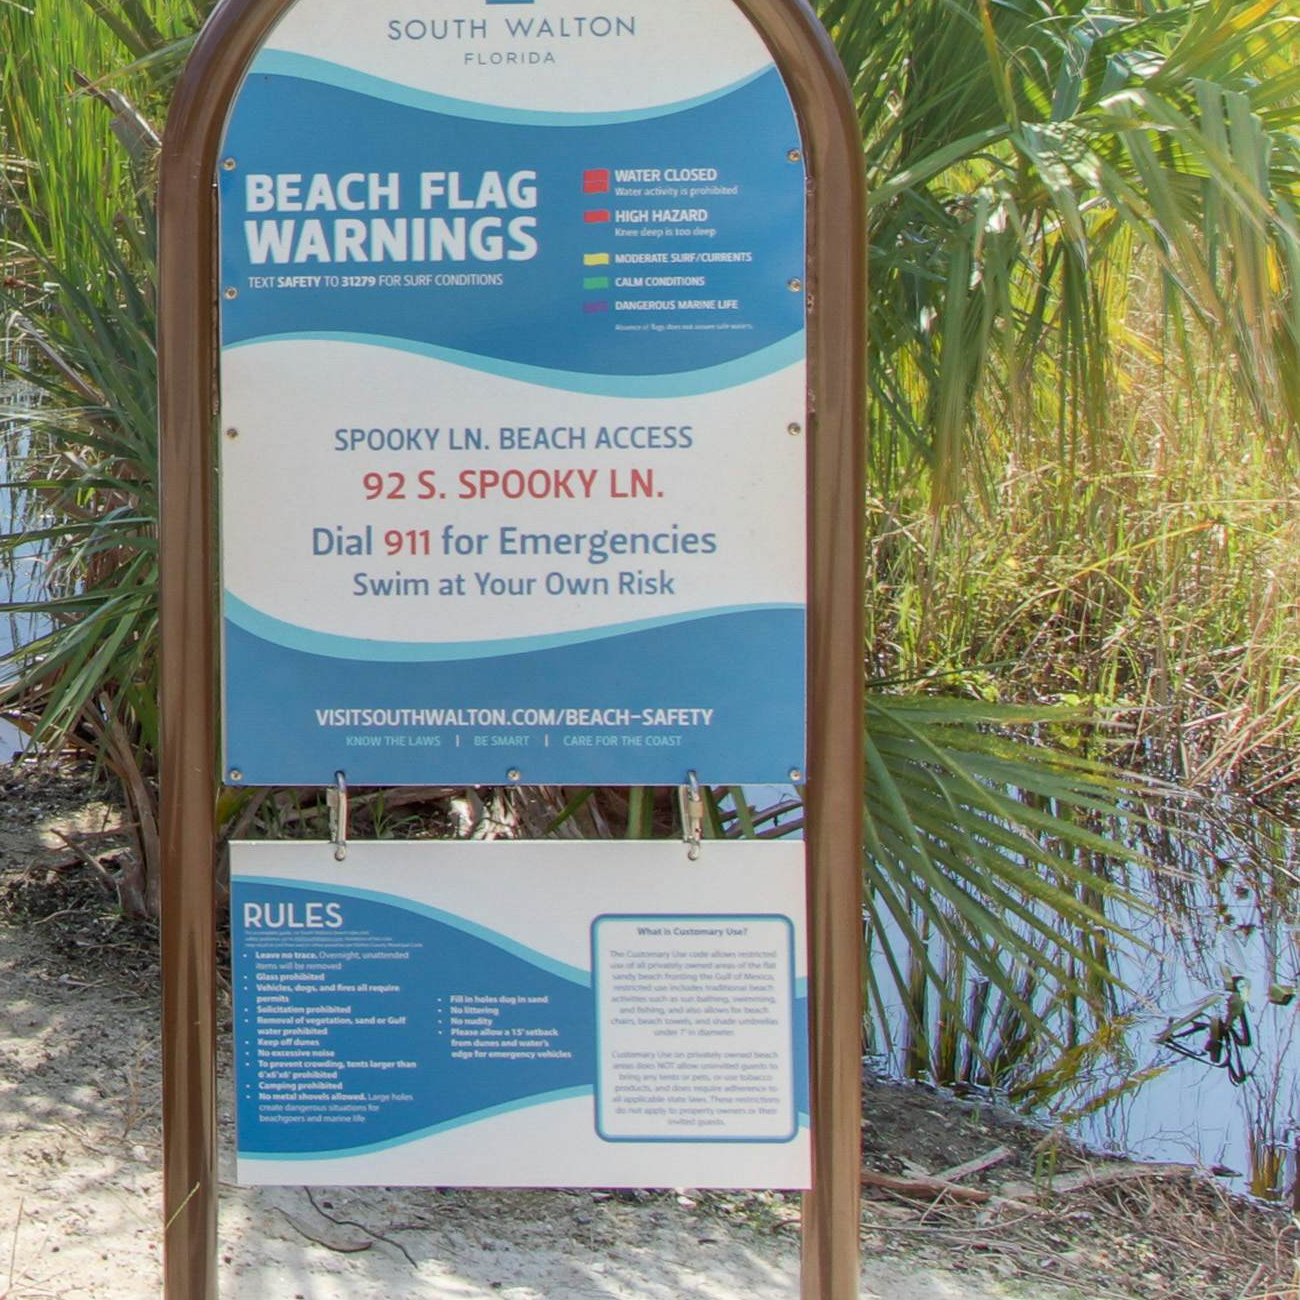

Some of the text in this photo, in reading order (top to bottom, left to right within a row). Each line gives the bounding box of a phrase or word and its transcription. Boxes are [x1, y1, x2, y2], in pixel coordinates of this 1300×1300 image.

[388, 16, 636, 40] SOUTH WALTON
[464, 52, 555, 65] FLORIDA
[615, 168, 717, 182] WATER CLOSED
[246, 170, 537, 212] BEACH FLAG
[615, 186, 737, 197] Water activity is prohibited
[615, 209, 708, 222] HIGH HAZARD
[615, 228, 638, 236] Knee
[641, 228, 663, 238] deep
[665, 228, 673, 236] is
[693, 228, 716, 237] deep
[244, 216, 538, 264] WARNINGS
[615, 252, 752, 263] MODERATE SURF/CURRENTS
[248, 274, 503, 288] TEXT SAFETY TO 31279 FOR SURF CONDITIONS
[615, 277, 705, 287] CALM CONDITIONS
[615, 300, 738, 310] DANGEROUS MARINE LIFE
[334, 426, 693, 452] SPOOKY LN. BEACH ACCESS
[363, 468, 664, 501] 92 S. SPOOKY LN.
[312, 524, 717, 564] Dial 911 for Emergencies
[353, 570, 675, 596] Swim at Your Own Risk
[315, 708, 713, 728] VISITSOUTHWALTON.COM/BEACH-SAFETY
[346, 736, 440, 746] KNOW THE LAWS
[474, 736, 529, 746] BE SMART
[563, 735, 682, 746] CARE FOR THE COAST
[243, 902, 343, 928] RULES
[637, 927, 748, 937] What is Customary Use?
[319, 952, 361, 960] Overnight,
[280, 973, 325, 982] prohibited
[256, 984, 293, 993] Vehicles,
[295, 984, 318, 993] dogs,
[369, 984, 399, 993] require
[256, 994, 289, 1003] permits
[450, 995, 548, 1005] Fill in holes dug in sand
[306, 1006, 351, 1015] prohibited
[450, 1006, 499, 1016] No littering
[306, 1017, 353, 1026] vegetation,
[464, 1018, 492, 1026] nudity
[283, 1028, 328, 1036] prohibited
[258, 1038, 279, 1047] Keep
[451, 1050, 472, 1059] edge
[270, 1060, 304, 1069] prevent
[305, 1060, 345, 1069] crowding,
[370, 1060, 395, 1069] larger
[293, 1071, 337, 1080] prohibited
[259, 1082, 343, 1091] Camping prohibited
[368, 1093, 390, 1102] Large
[284, 1104, 326, 1113] dangerous
[260, 1115, 305, 1124] beachgoers
